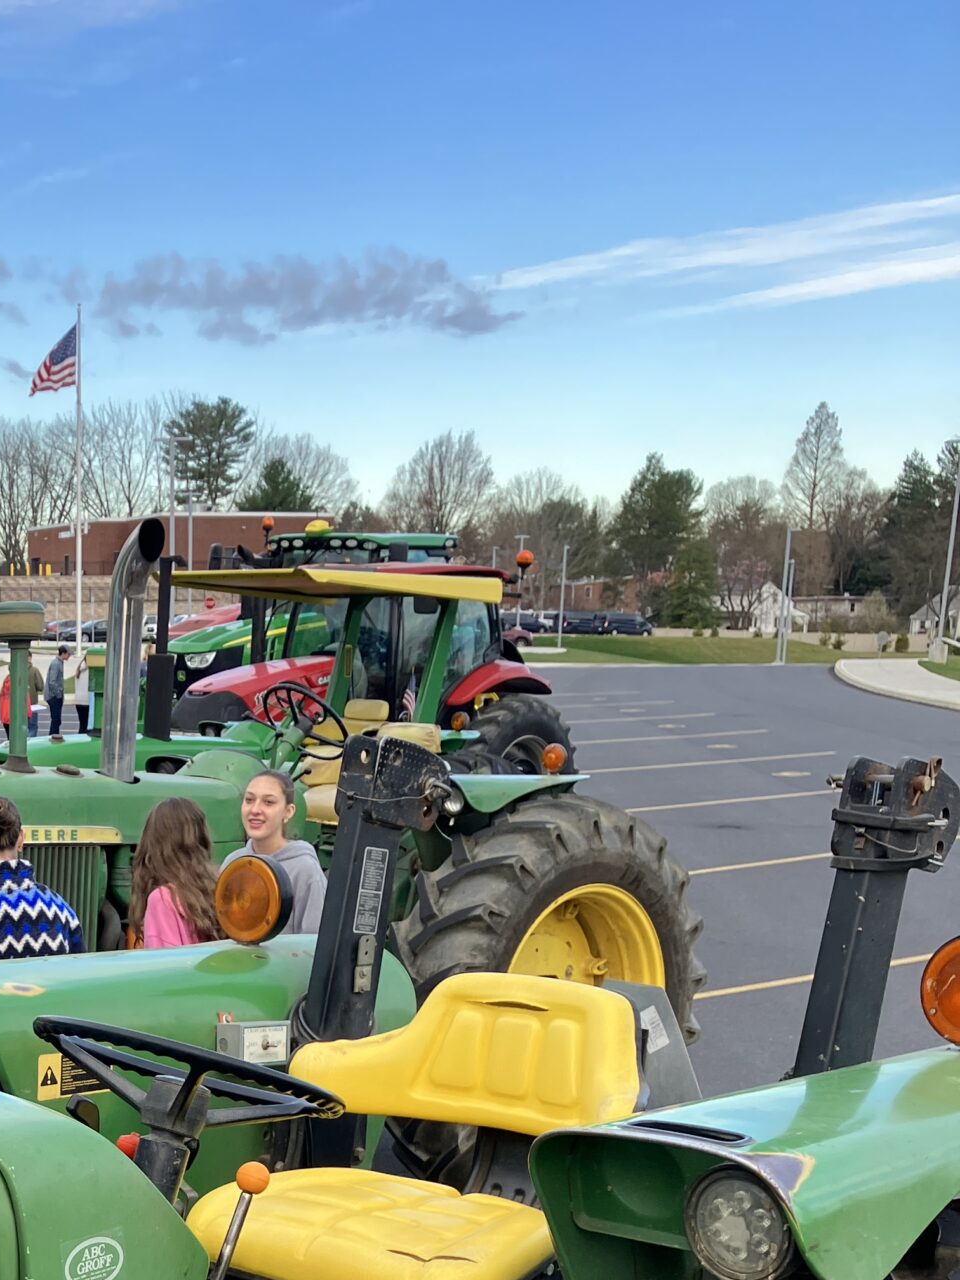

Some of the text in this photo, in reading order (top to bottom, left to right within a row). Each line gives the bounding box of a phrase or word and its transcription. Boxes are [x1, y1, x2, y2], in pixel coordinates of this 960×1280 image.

[31, 829, 78, 841] EERE
[82, 1244, 106, 1261] ABC
[77, 1253, 114, 1275] GROFF
